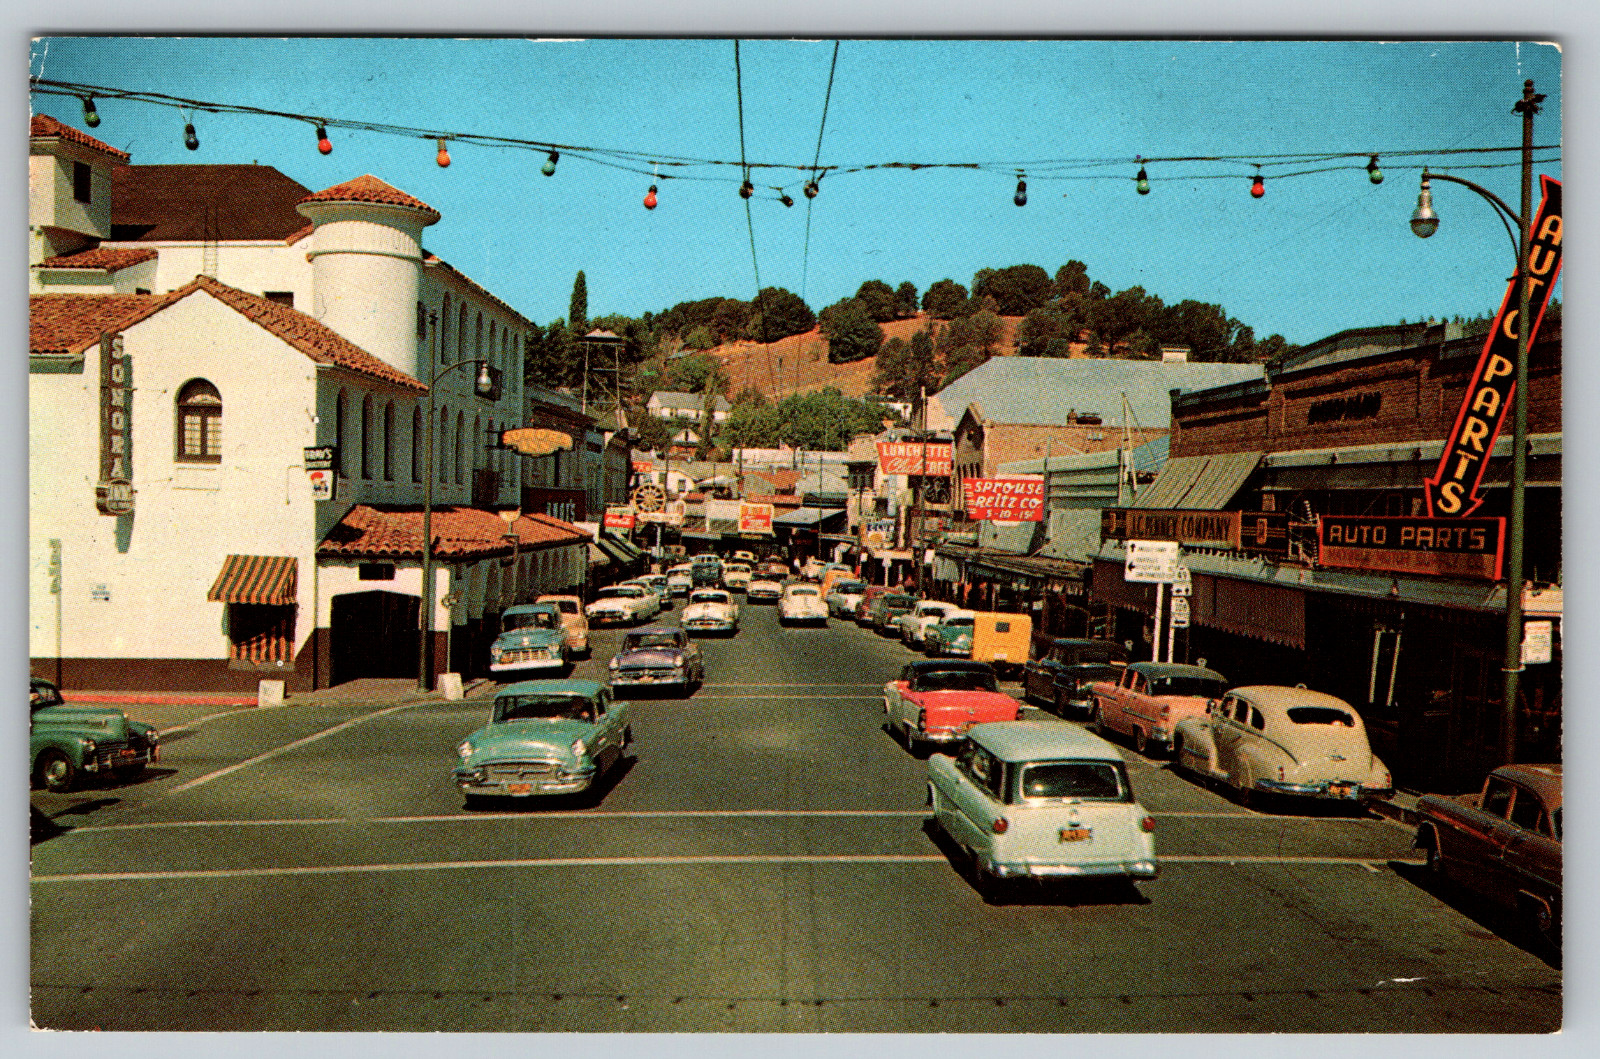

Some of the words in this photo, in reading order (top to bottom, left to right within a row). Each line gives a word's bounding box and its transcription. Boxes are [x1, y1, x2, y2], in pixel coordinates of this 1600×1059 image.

[110, 336, 125, 479] SONORA
[1437, 353, 1513, 514] PARTS
[1181, 516, 1231, 540] COMPANY
[1329, 525, 1387, 544] AUTO
[1400, 527, 1486, 550] PARTS
